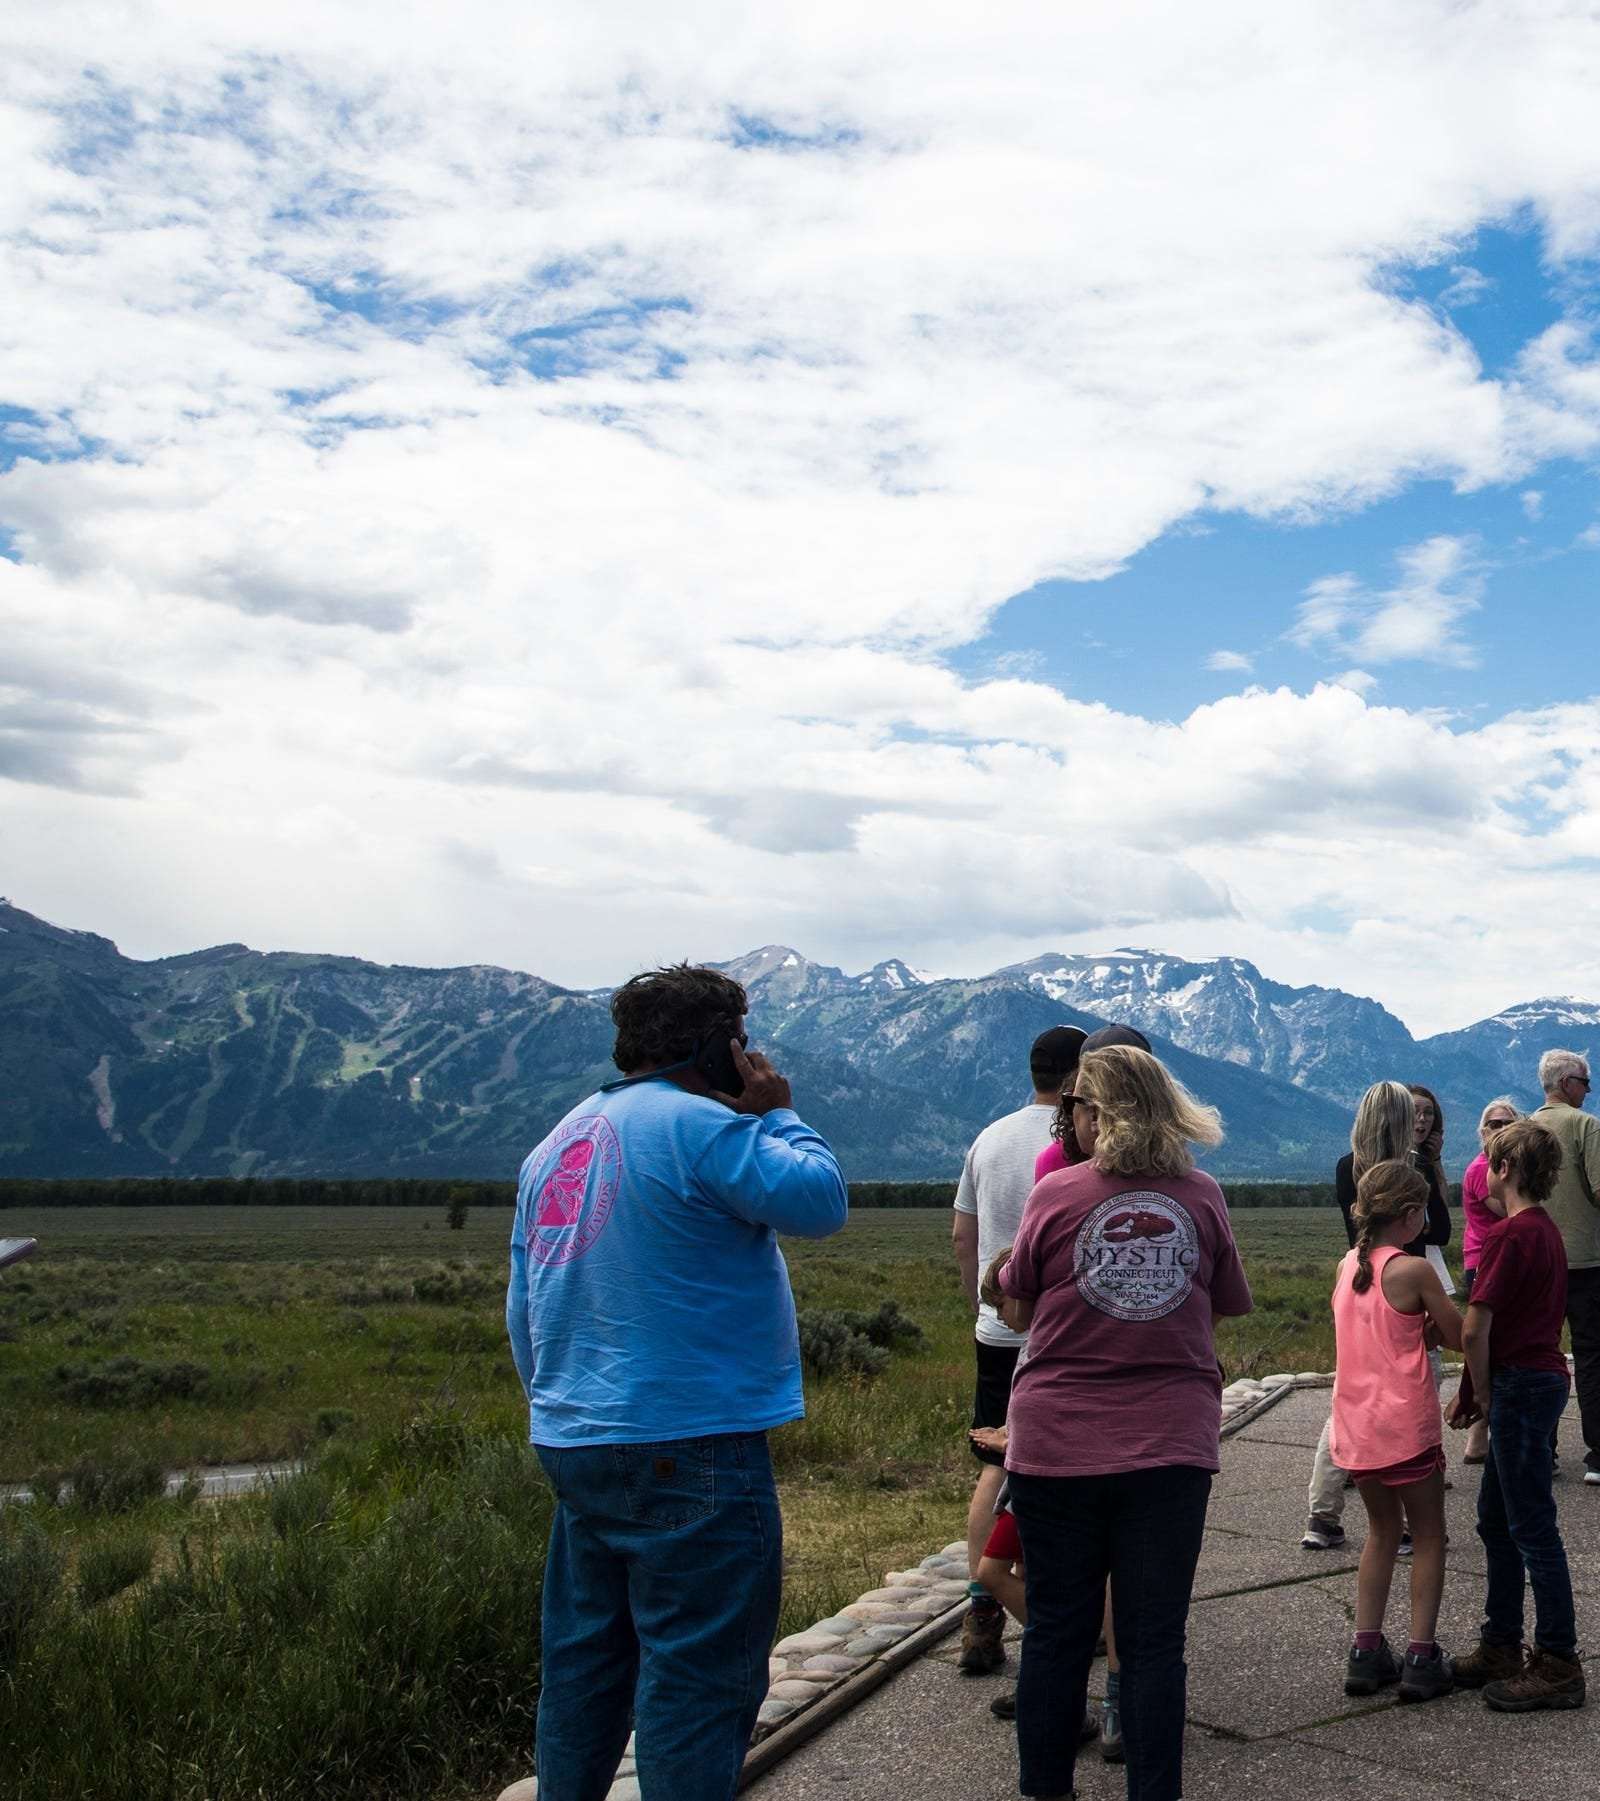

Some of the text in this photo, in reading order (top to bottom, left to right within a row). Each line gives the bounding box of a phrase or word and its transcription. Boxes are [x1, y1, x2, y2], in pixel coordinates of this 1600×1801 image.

[1081, 1246, 1194, 1267] MYSTIC
[1098, 1268, 1177, 1279] CONNECTICUT
[1116, 1291, 1142, 1299] SINCE
